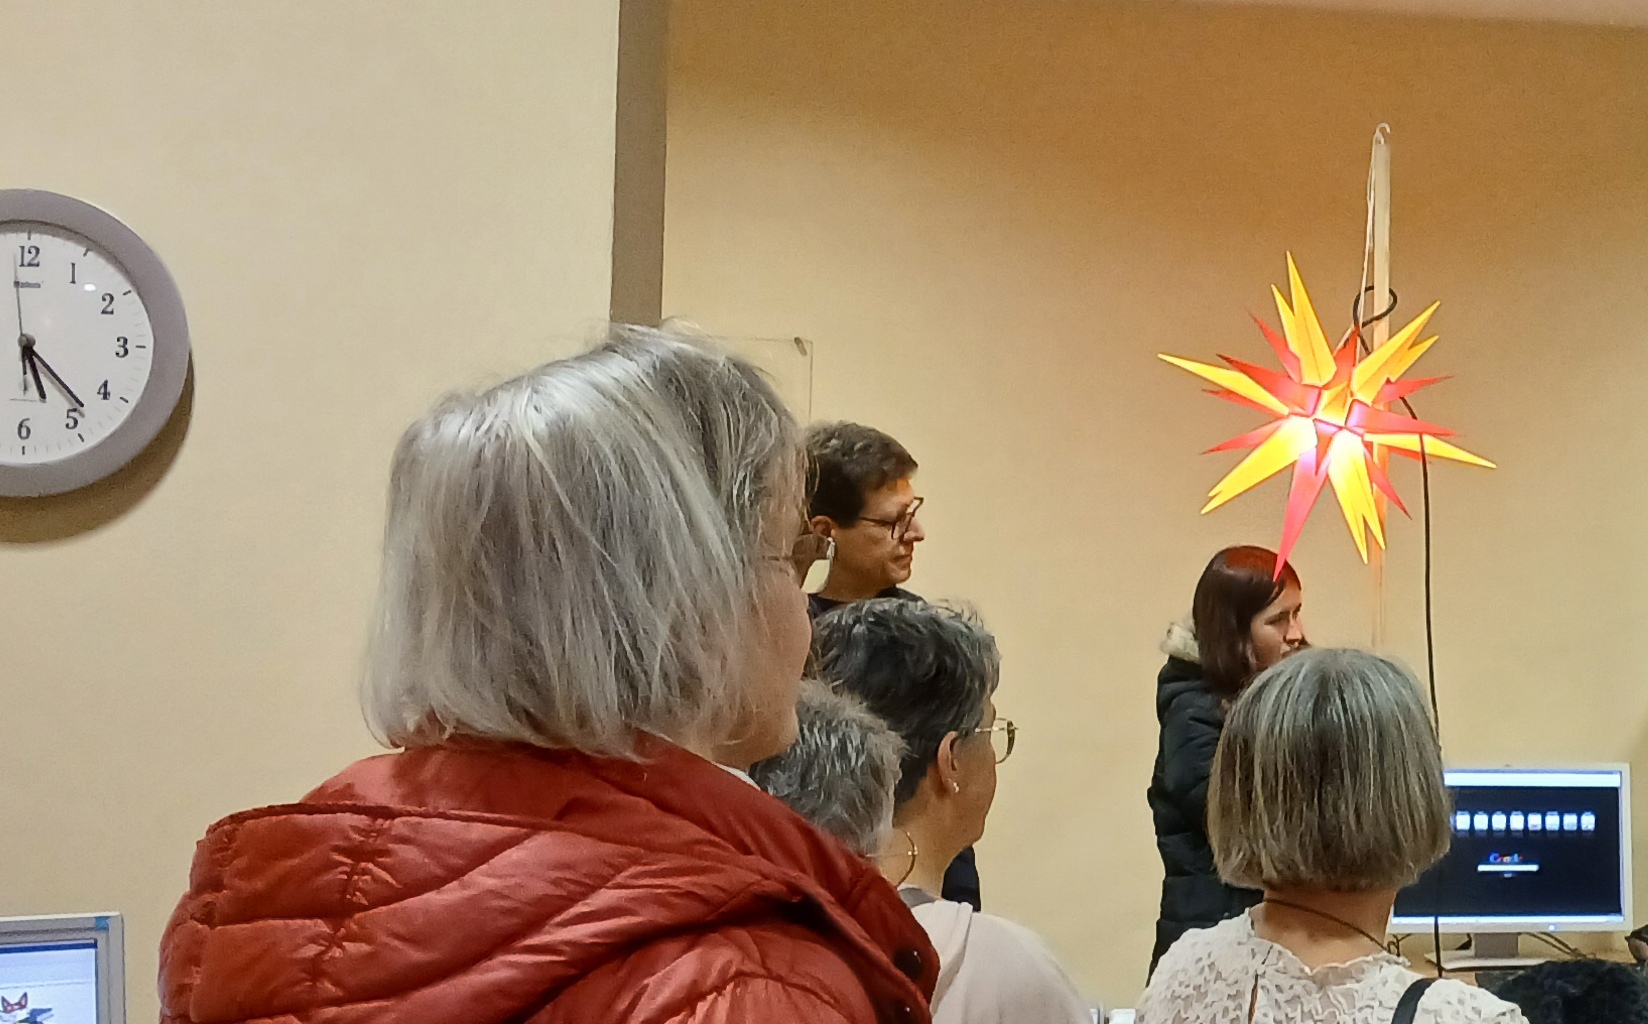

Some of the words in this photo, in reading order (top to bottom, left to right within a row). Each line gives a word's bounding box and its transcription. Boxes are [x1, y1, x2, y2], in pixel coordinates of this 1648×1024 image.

[18, 245, 41, 268] 12
[69, 262, 77, 285] 1
[100, 292, 115, 315] 2
[115, 336, 129, 358] 3
[96, 379, 112, 401] 4
[17, 417, 31, 440] 6
[65, 407, 79, 430] 5
